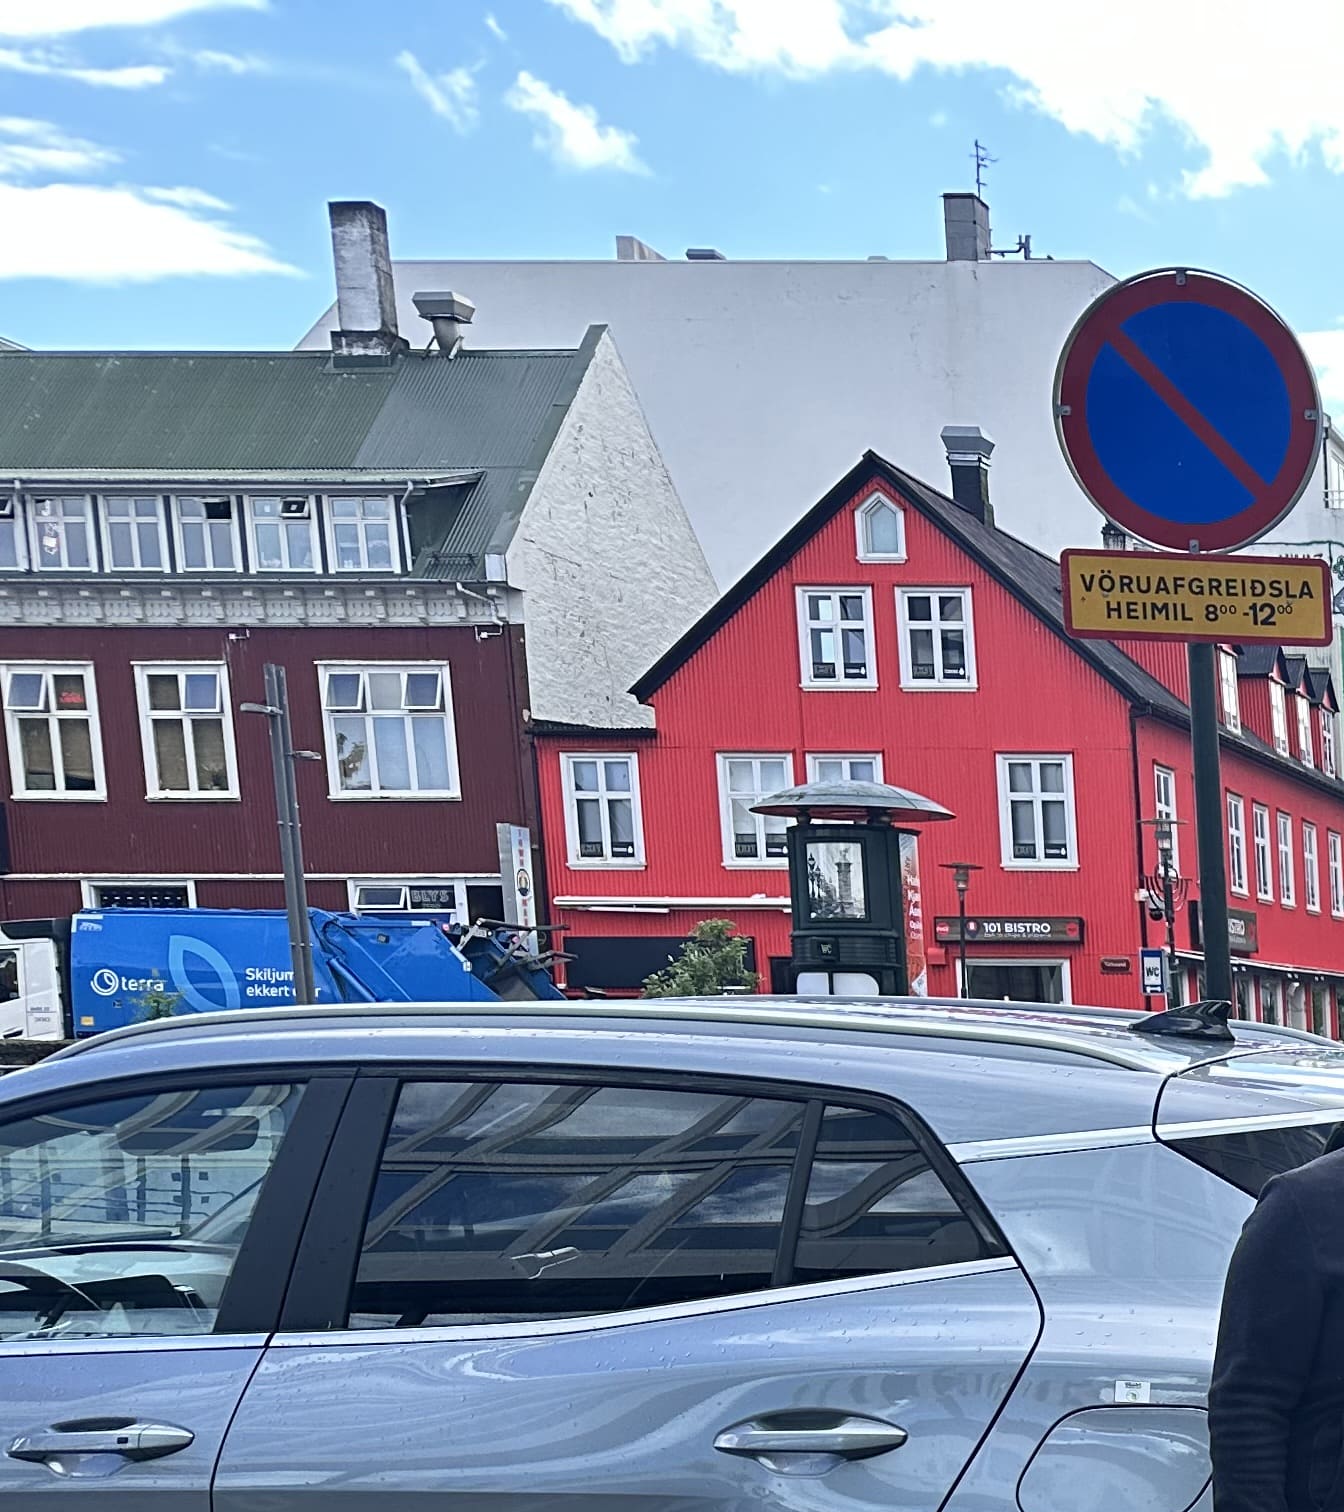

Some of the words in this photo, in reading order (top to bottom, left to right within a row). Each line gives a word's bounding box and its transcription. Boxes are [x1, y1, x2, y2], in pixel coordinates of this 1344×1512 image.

[1080, 569, 1314, 599] VÖRUAFGREIÐSLA
[1106, 600, 1193, 622] HEIMIL
[983, 922, 1001, 933] 101
[1004, 922, 1051, 933] BISTRO
[821, 944, 833, 954] WC
[1146, 967, 1160, 977] WC
[121, 977, 164, 992] terra
[247, 985, 290, 997] ekkert
